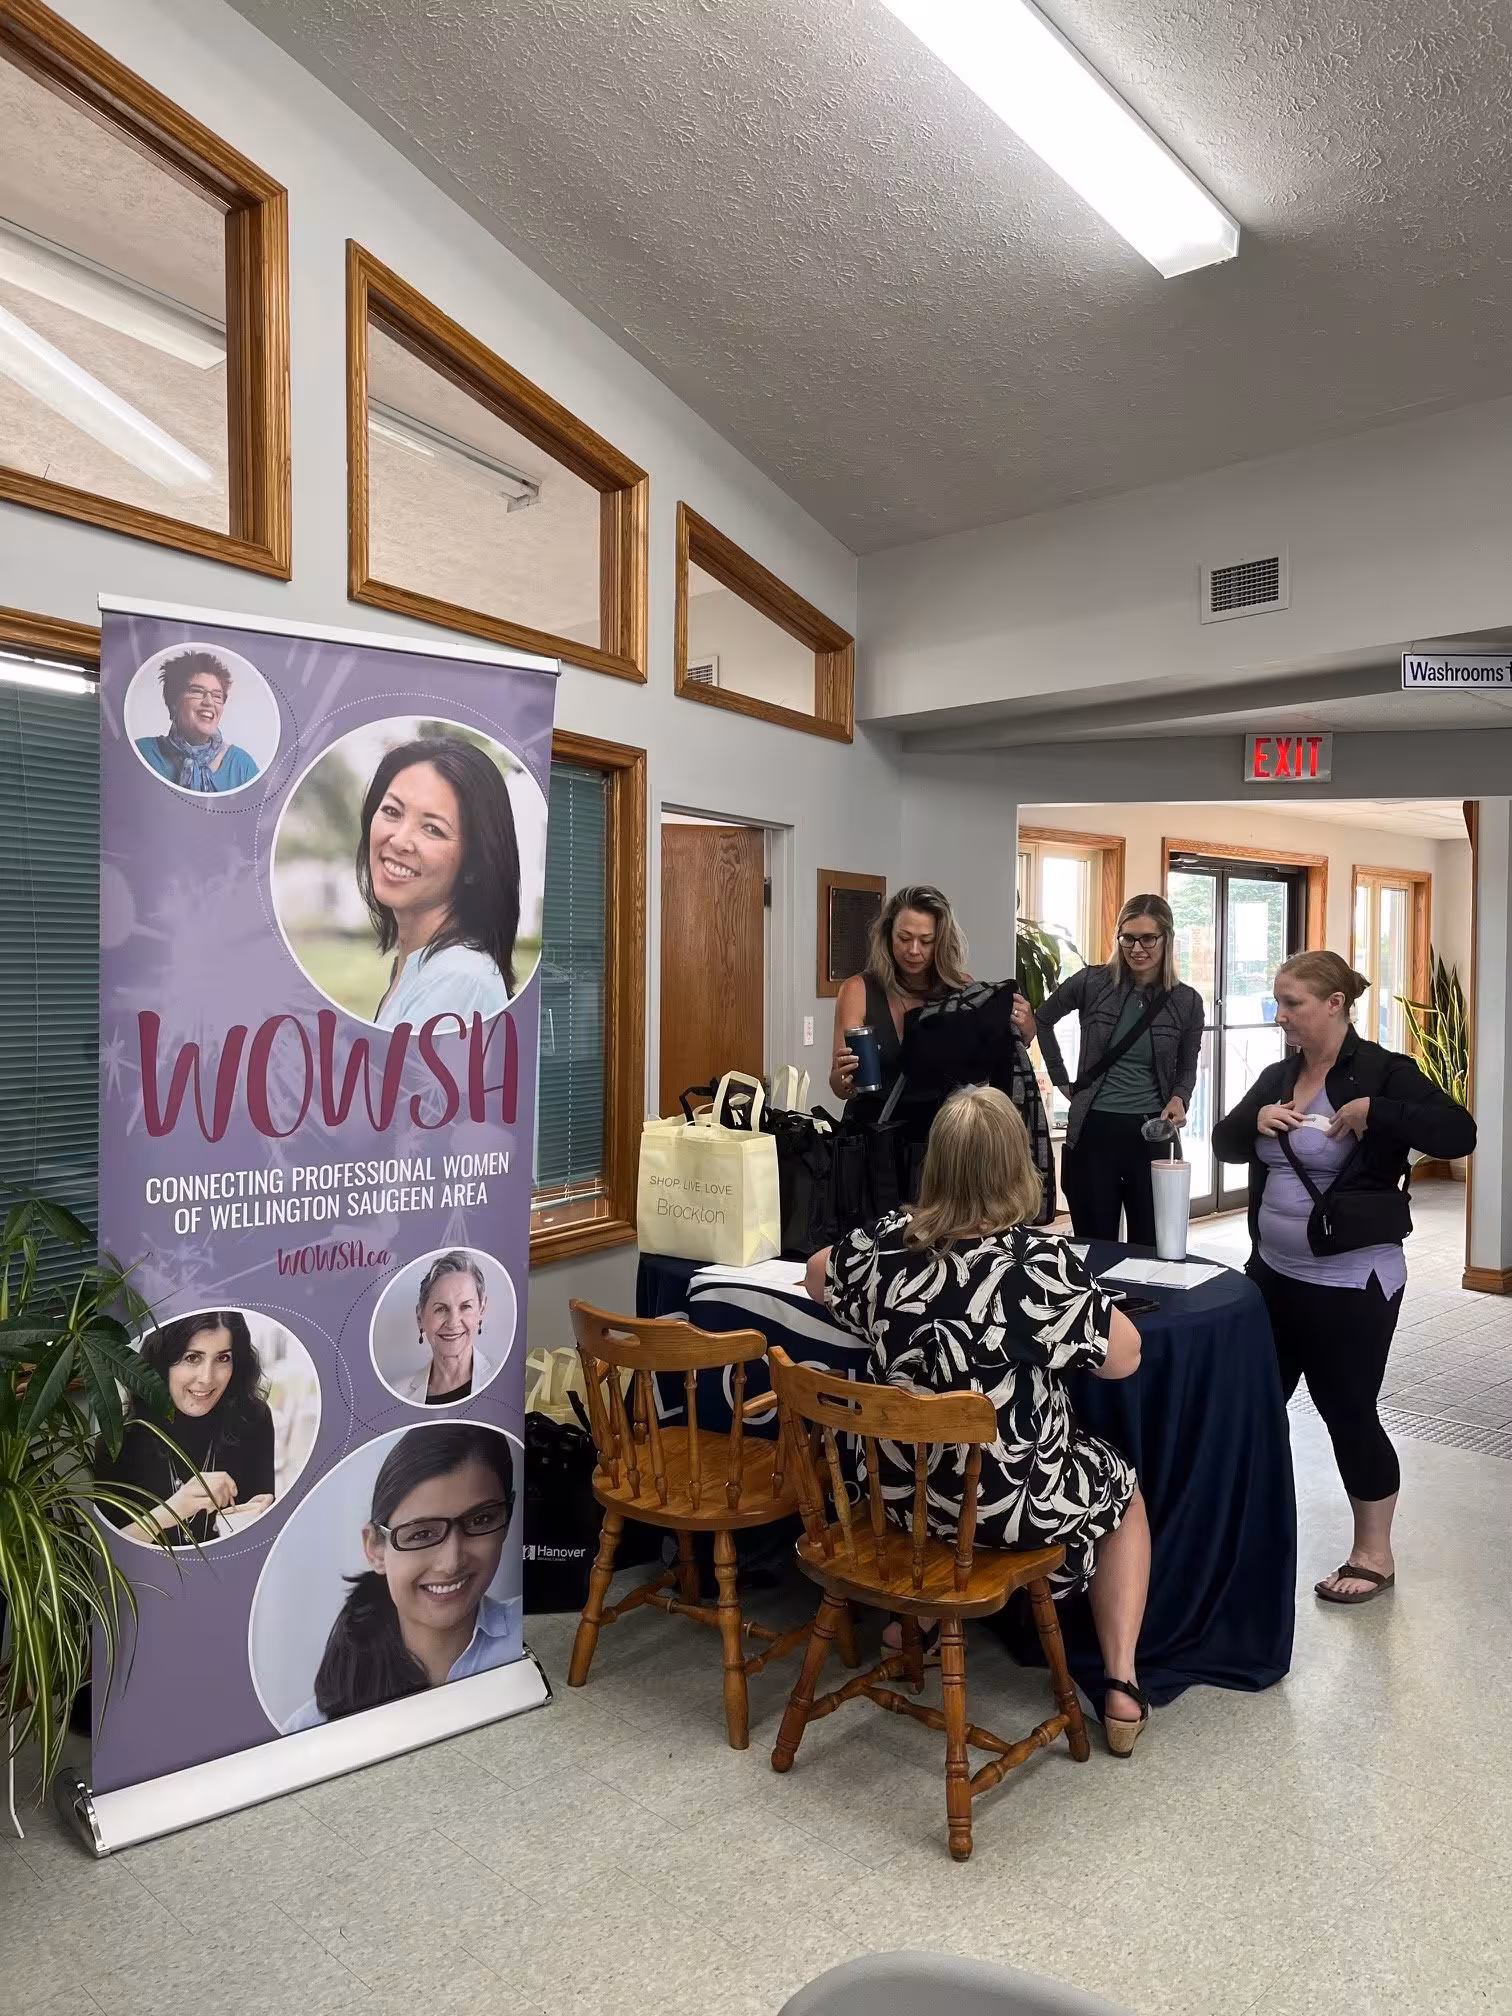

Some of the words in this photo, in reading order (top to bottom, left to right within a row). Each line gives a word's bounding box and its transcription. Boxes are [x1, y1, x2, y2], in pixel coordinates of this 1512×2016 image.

[1409, 661, 1504, 682] Washrooms
[1253, 736, 1323, 778] EXIT
[137, 1008, 519, 1143] WOWSA
[145, 1168, 284, 1205] CONNECTING
[291, 1157, 436, 1192] PROFESSIONAL
[442, 1151, 510, 1179] WOMEN
[705, 1184, 733, 1195] LOVE
[174, 1206, 203, 1235] OF
[209, 1193, 340, 1231] WELLINGTON
[347, 1185, 434, 1217] SAUGEEN
[440, 1181, 488, 1209] AREA
[657, 1198, 725, 1224] Brockton
[277, 1239, 392, 1276] WOWSA.ca
[537, 1544, 587, 1558] Hanover
